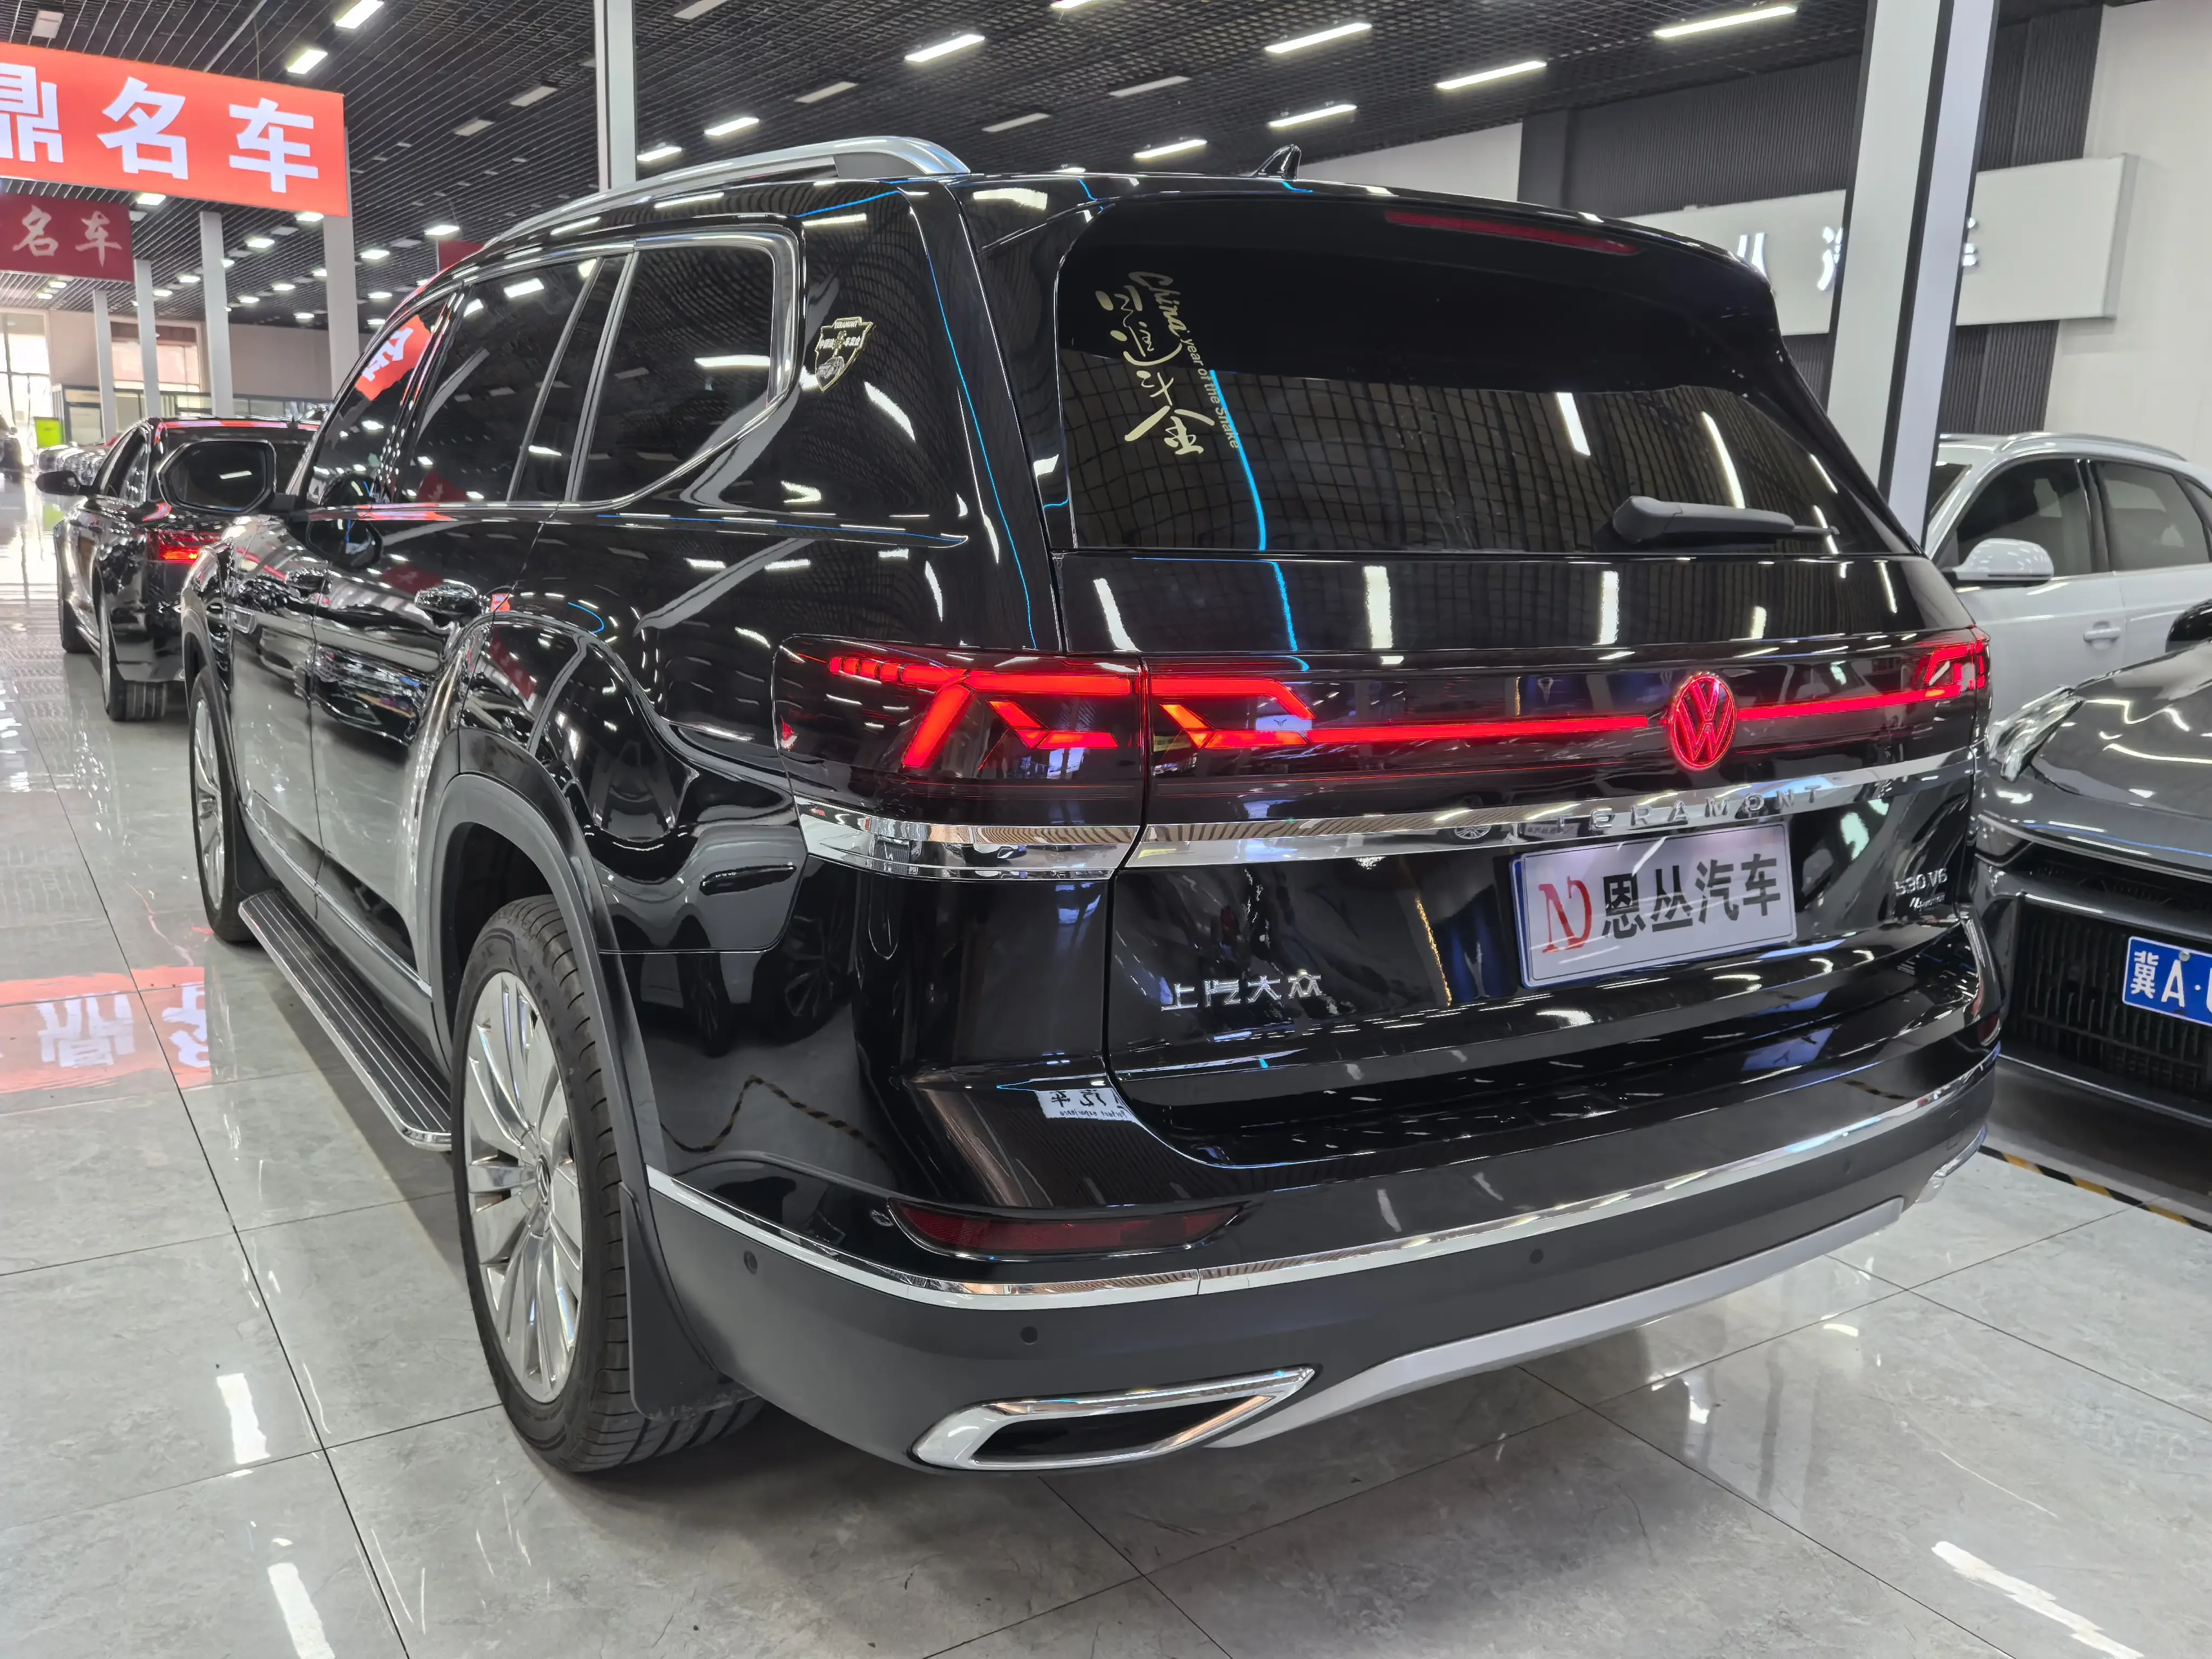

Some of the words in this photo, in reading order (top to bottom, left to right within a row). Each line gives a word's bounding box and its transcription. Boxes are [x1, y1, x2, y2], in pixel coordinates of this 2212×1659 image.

[12, 204, 122, 267] 名车
[1181, 338, 1204, 366] year
[1198, 368, 1214, 380] of
[1204, 383, 1220, 404] the
[1549, 785, 1822, 835] TERAMONT
[1602, 853, 1781, 940] 恩丛汽车
[1927, 867, 1947, 887] V6
[1161, 970, 1322, 1011] 上汽大众
[2130, 950, 2212, 1014] 冀A·
